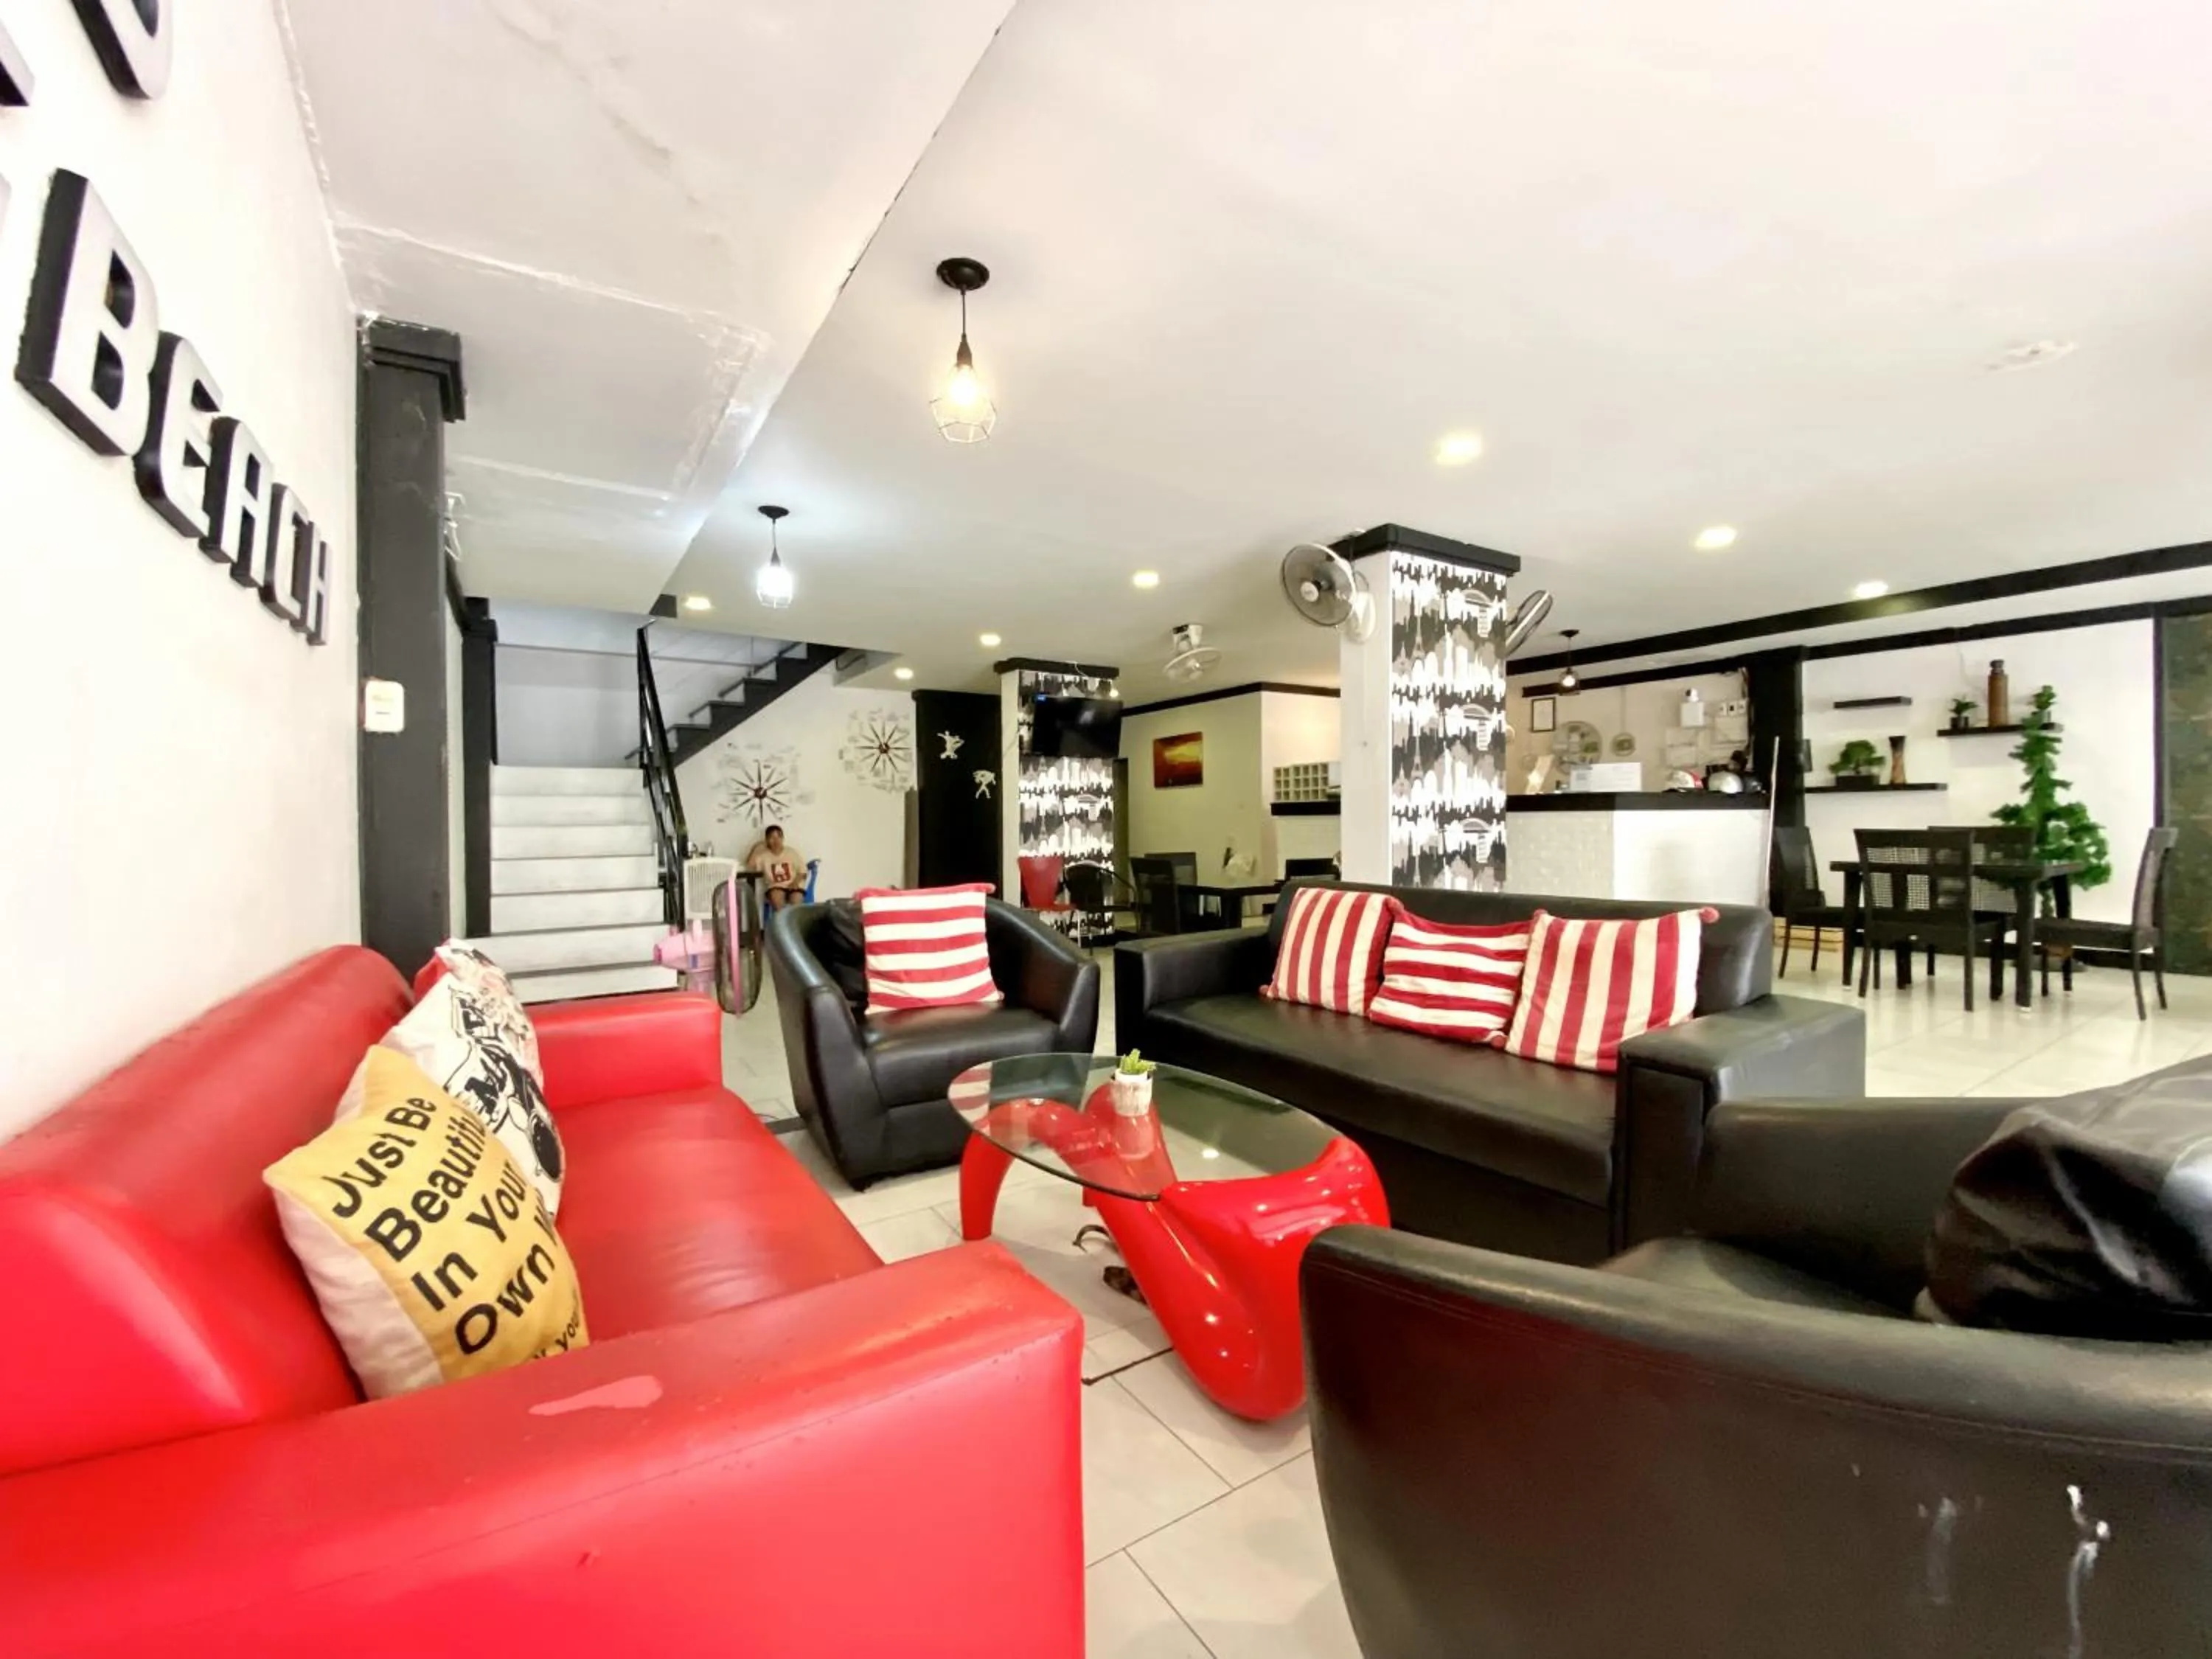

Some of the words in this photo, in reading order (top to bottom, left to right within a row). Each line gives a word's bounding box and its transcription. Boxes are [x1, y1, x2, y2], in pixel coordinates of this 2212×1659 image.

[15, 167, 331, 646] BEACH
[320, 1133, 417, 1219] Just
[384, 1097, 437, 1131] Be
[364, 1116, 487, 1262] Beautifu
[410, 1252, 479, 1312] In
[465, 1161, 526, 1242] Your
[455, 1243, 554, 1354] Own
